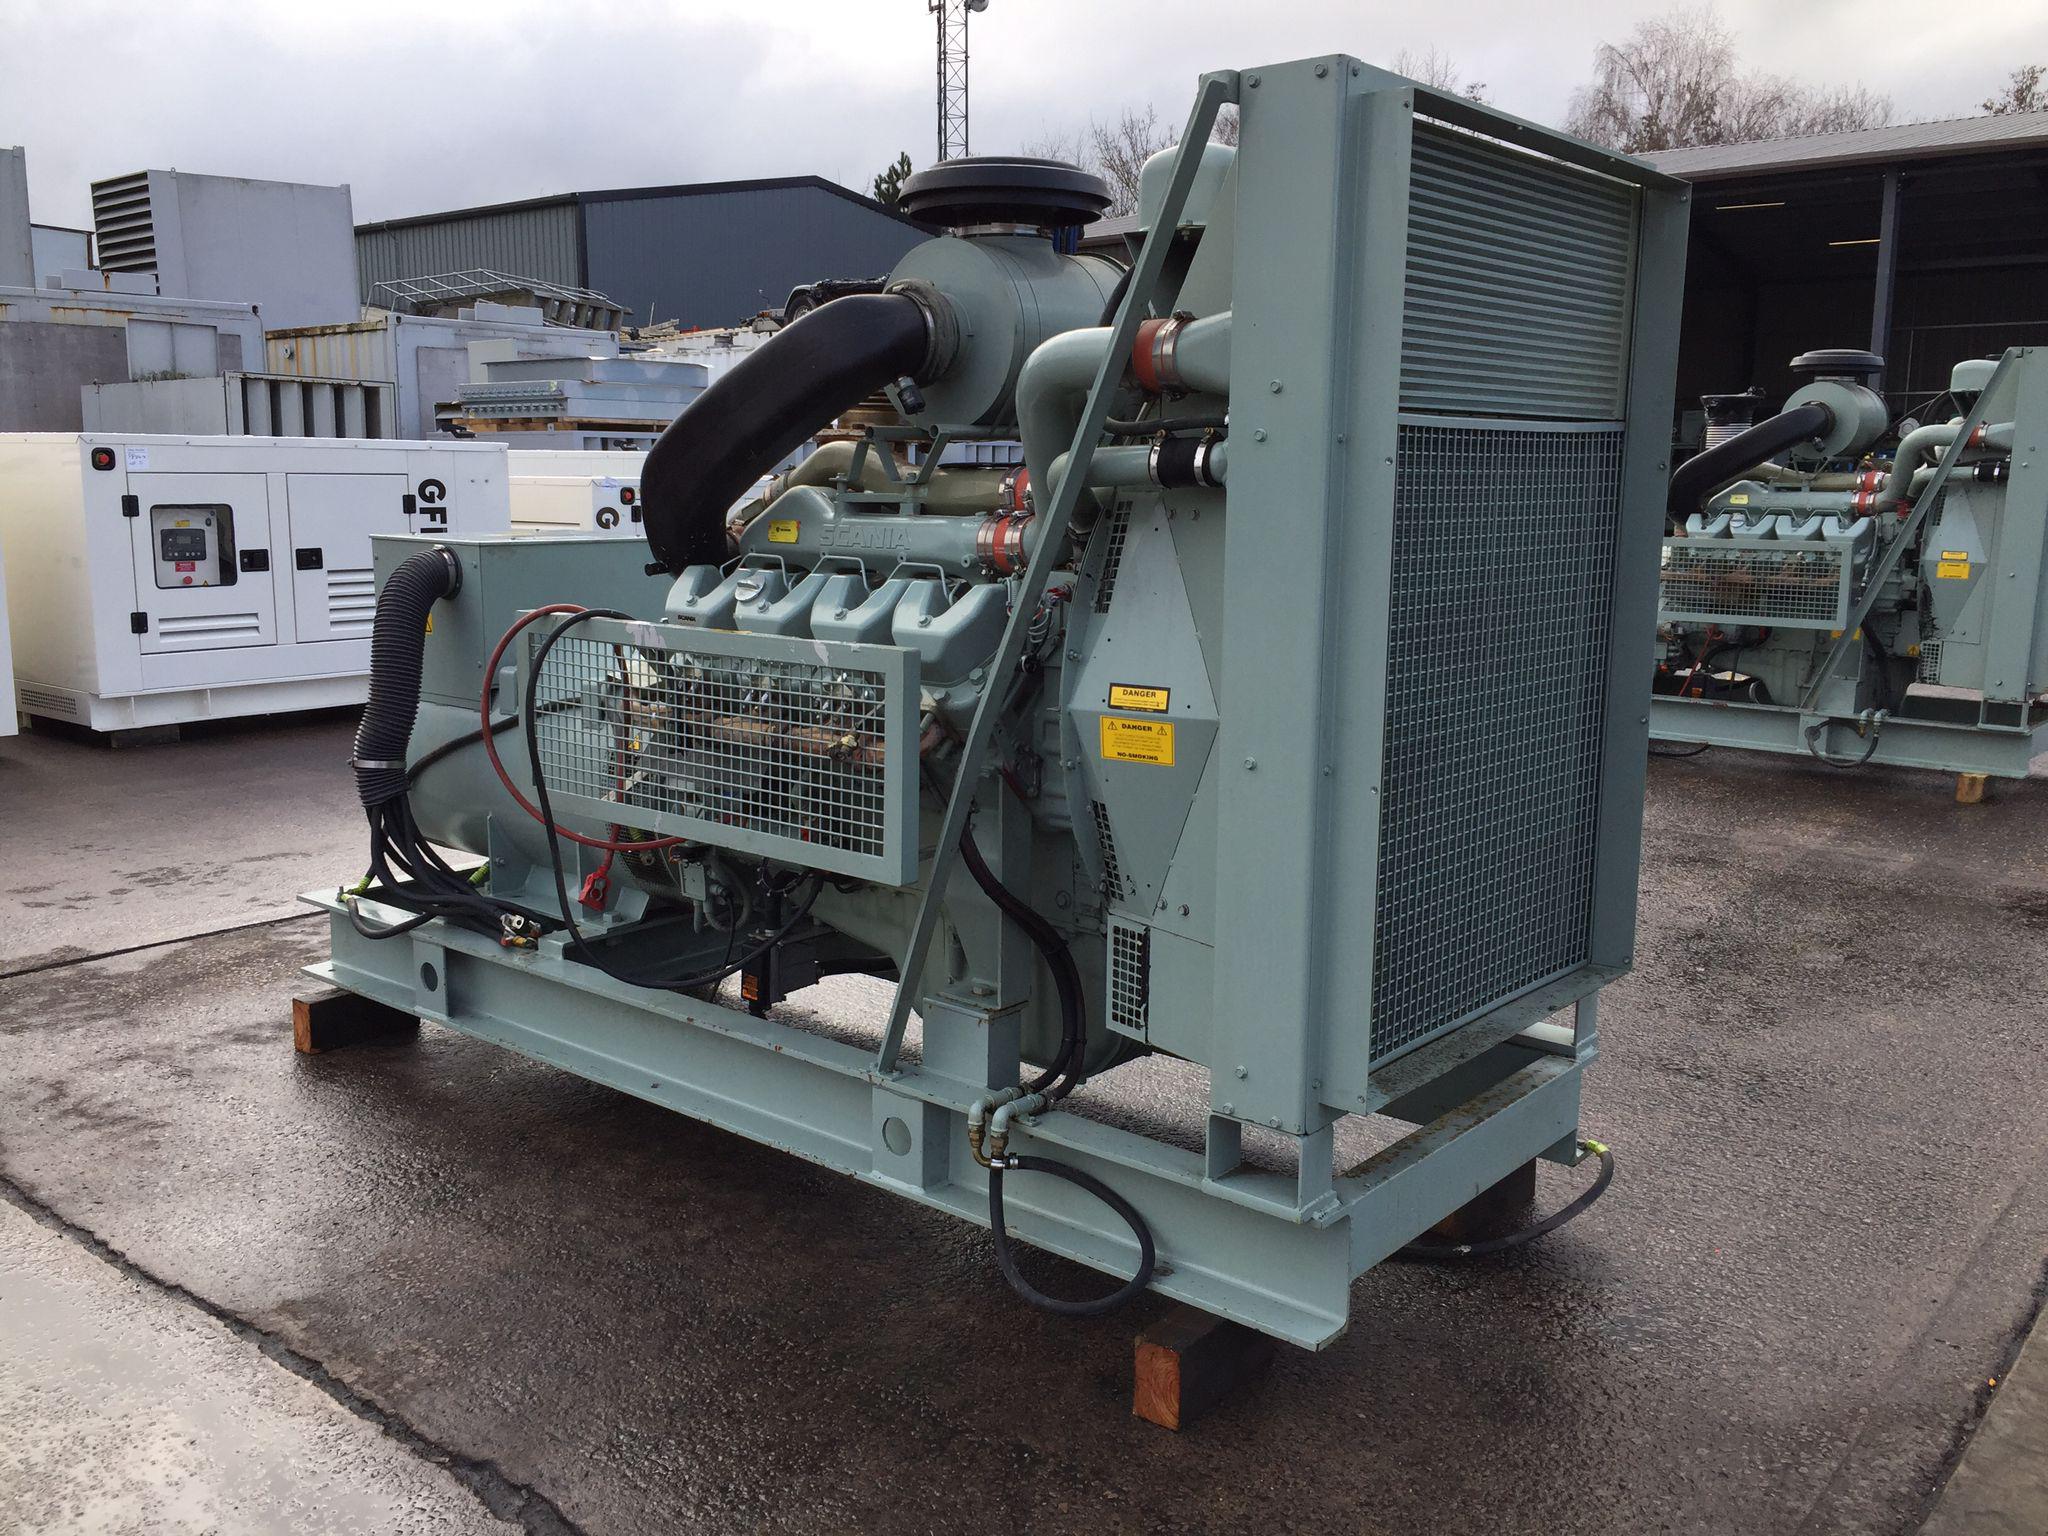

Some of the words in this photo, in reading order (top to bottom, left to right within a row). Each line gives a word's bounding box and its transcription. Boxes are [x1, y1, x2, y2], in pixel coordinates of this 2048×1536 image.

[820, 524, 911, 550] SCANIA
[1122, 689, 1157, 698] DANGER
[1121, 723, 1153, 732] DANGER
[1117, 752, 1159, 761] NO-SMOKING
